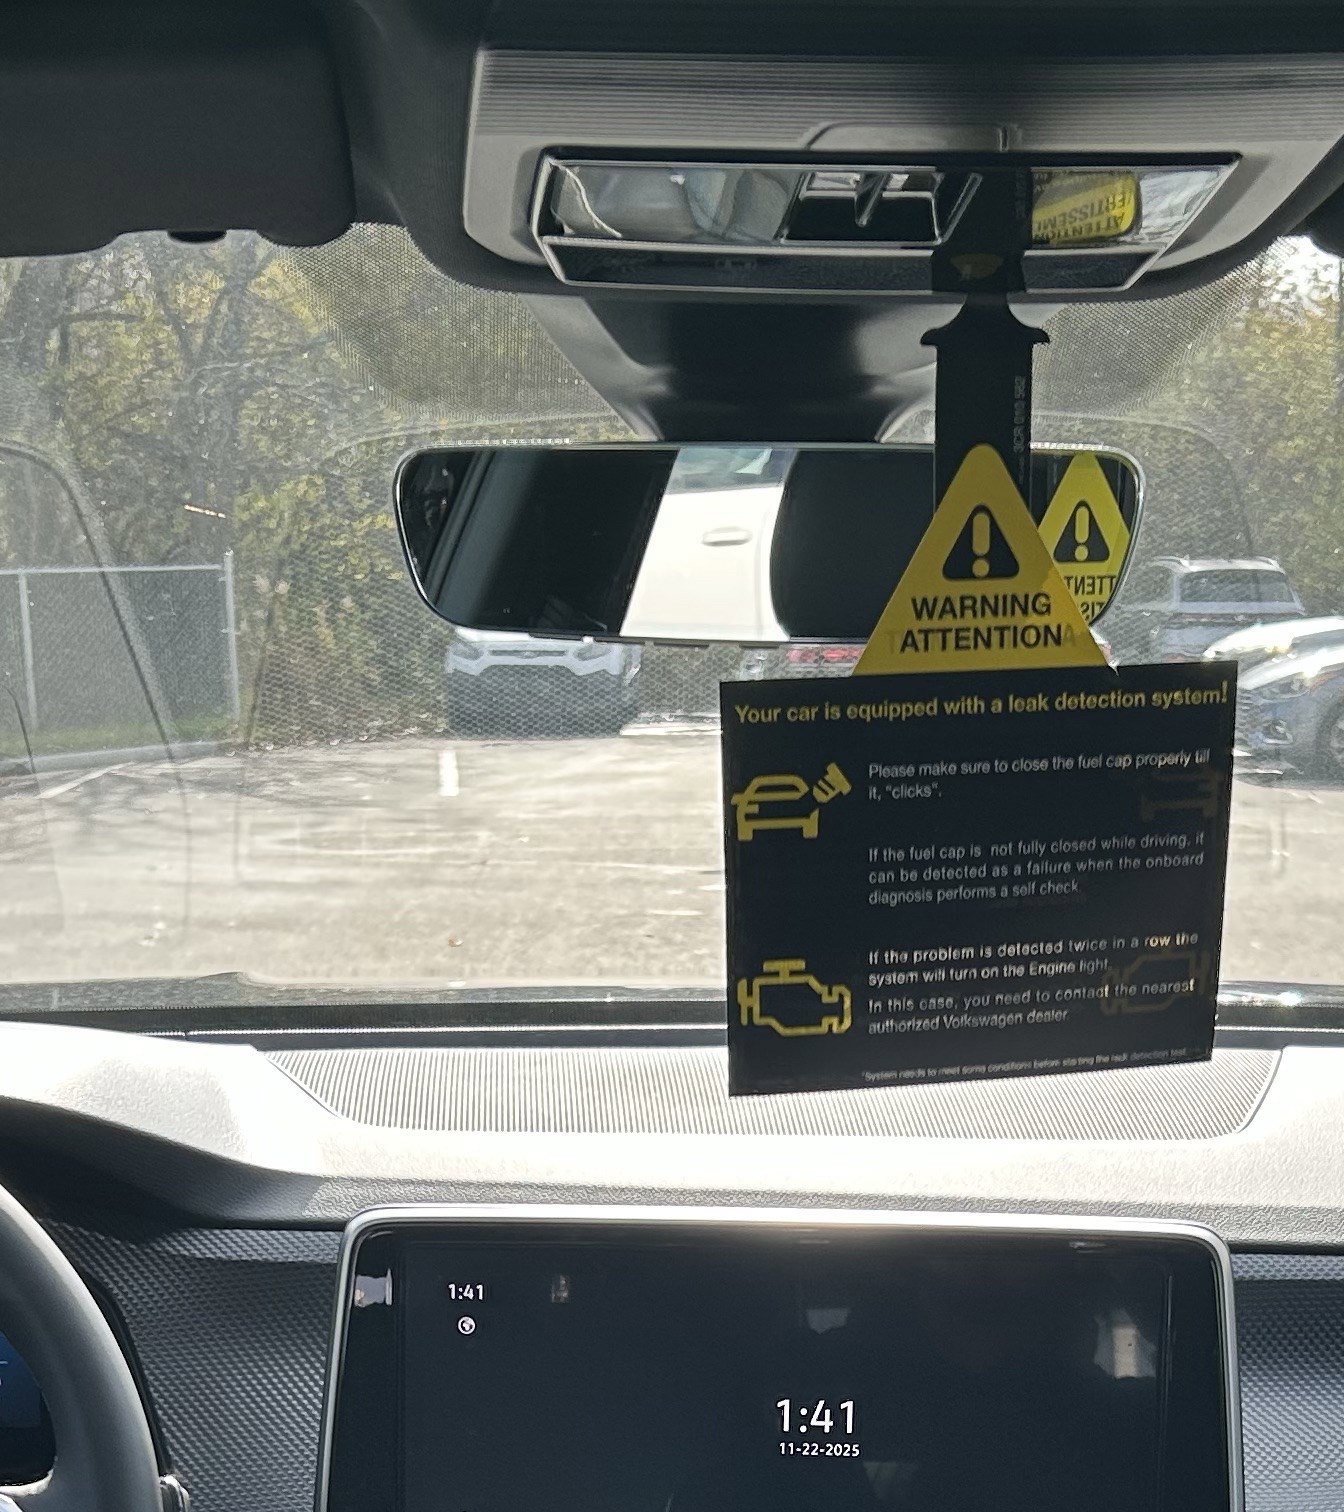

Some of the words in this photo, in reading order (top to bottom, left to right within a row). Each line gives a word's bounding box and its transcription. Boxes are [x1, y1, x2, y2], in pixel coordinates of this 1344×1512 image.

[910, 592, 1051, 621] WARNING
[899, 623, 1065, 653] ATTENTION
[734, 704, 782, 724] Your
[786, 705, 819, 722] car
[824, 701, 841, 720] is
[846, 700, 938, 722] equipped
[943, 695, 985, 715] with
[990, 697, 1003, 714] a
[1008, 692, 1049, 713] leak
[1054, 689, 1146, 711] detection
[1151, 685, 1228, 707] system!
[868, 762, 915, 779] Please
[918, 762, 957, 776] make
[960, 761, 991, 775] sure
[994, 759, 1008, 773] to
[1011, 758, 1049, 772] close
[1051, 755, 1075, 770] the
[1077, 753, 1103, 769] fuel
[1105, 754, 1132, 769] cap
[1135, 751, 1191, 769] properly
[868, 846, 879, 863] If
[882, 846, 905, 862] the
[909, 843, 935, 861] fuel
[939, 845, 967, 860] cap
[969, 843, 982, 858] is
[990, 841, 1013, 857] not
[1017, 838, 1046, 857] fully
[1050, 836, 1097, 853] closed
[1100, 835, 1136, 850] while
[1195, 830, 1204, 845] it
[868, 870, 895, 884] can
[899, 867, 918, 882] be
[922, 863, 987, 881] detected
[991, 864, 1009, 878] as
[1013, 863, 1023, 877] a
[1026, 859, 1071, 875] failure
[1075, 858, 1114, 872] when
[1118, 855, 1141, 870] the
[1145, 852, 1204, 868] onboard
[868, 949, 879, 965] If
[883, 949, 908, 964] the
[913, 946, 974, 962] problem
[979, 944, 992, 958] is
[997, 940, 1063, 957] detected
[1068, 939, 1107, 952] twice
[1112, 936, 1125, 949] in
[1130, 936, 1139, 948] a
[1144, 935, 1173, 947] row
[1175, 931, 1198, 946] the
[868, 998, 882, 1014] In
[887, 996, 914, 1012] this
[963, 994, 991, 1011] you
[994, 990, 1031, 1005] need
[1035, 989, 1050, 1003] to
[1054, 984, 1109, 1001] contact
[1114, 982, 1137, 1001] the
[1141, 979, 1195, 995] nearest
[868, 1015, 940, 1034] authorized
[942, 1012, 1023, 1029] Volkswagen
[447, 1282, 485, 1302] 1:41
[775, 1396, 859, 1437] 1:41
[778, 1441, 861, 1459] 11-22-2025
